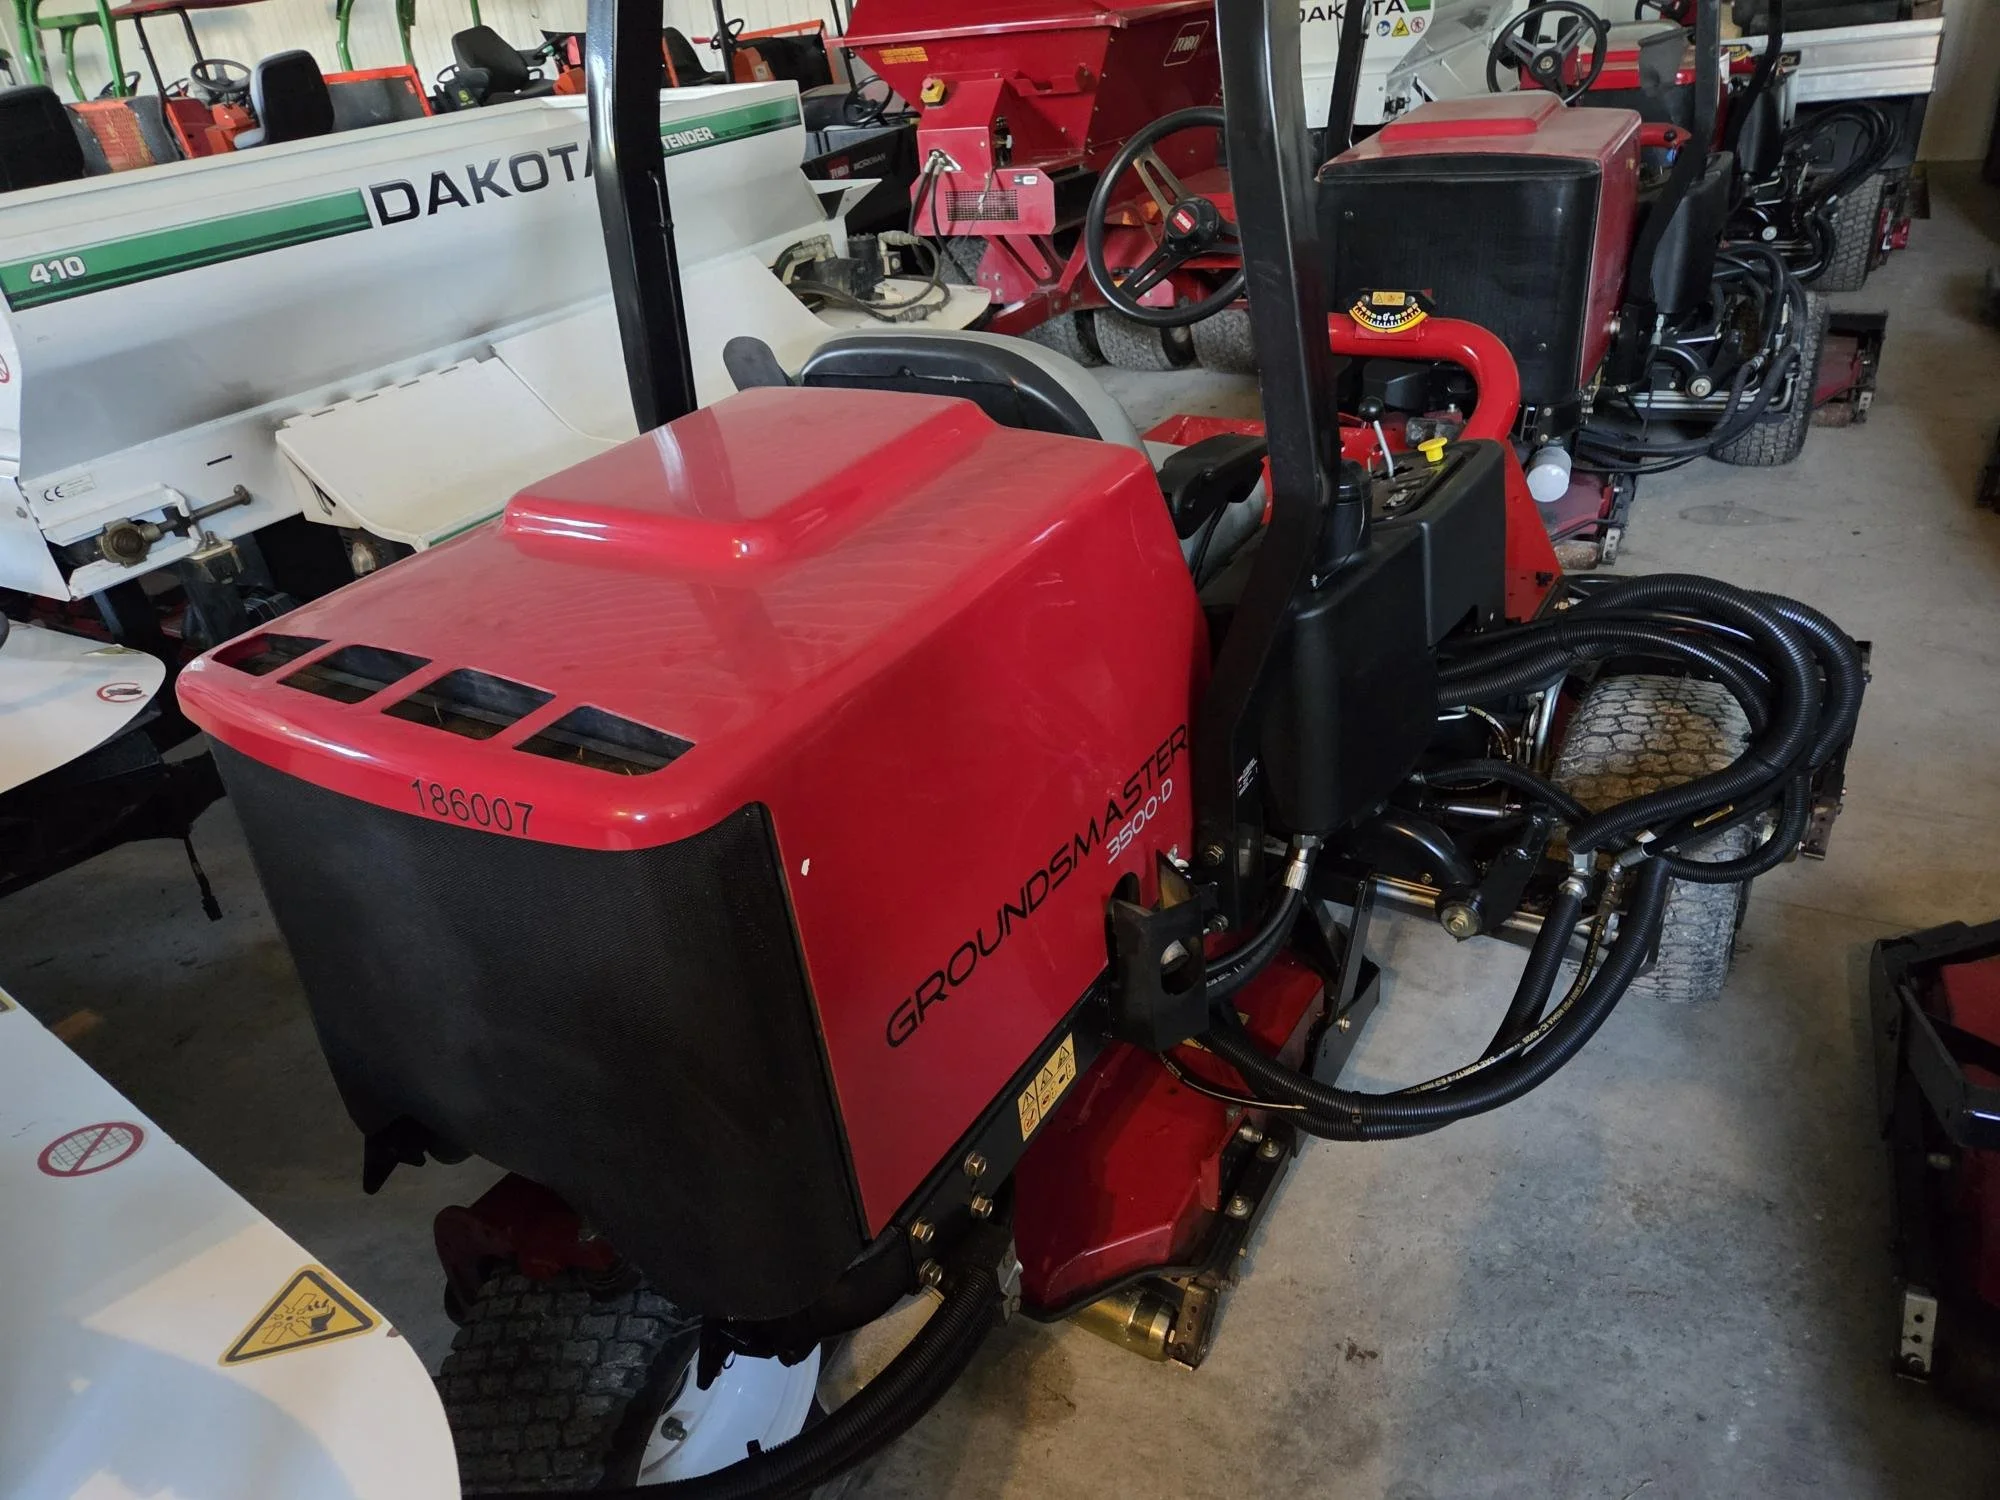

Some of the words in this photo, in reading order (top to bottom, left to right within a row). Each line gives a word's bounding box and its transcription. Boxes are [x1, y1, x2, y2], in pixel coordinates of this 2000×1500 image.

[1300, 0, 1405, 23] AKTA
[369, 141, 593, 226] DAKOT
[30, 256, 86, 283] 410
[412, 780, 533, 834] 186007
[886, 724, 1188, 1048] GROUNDSMASTER
